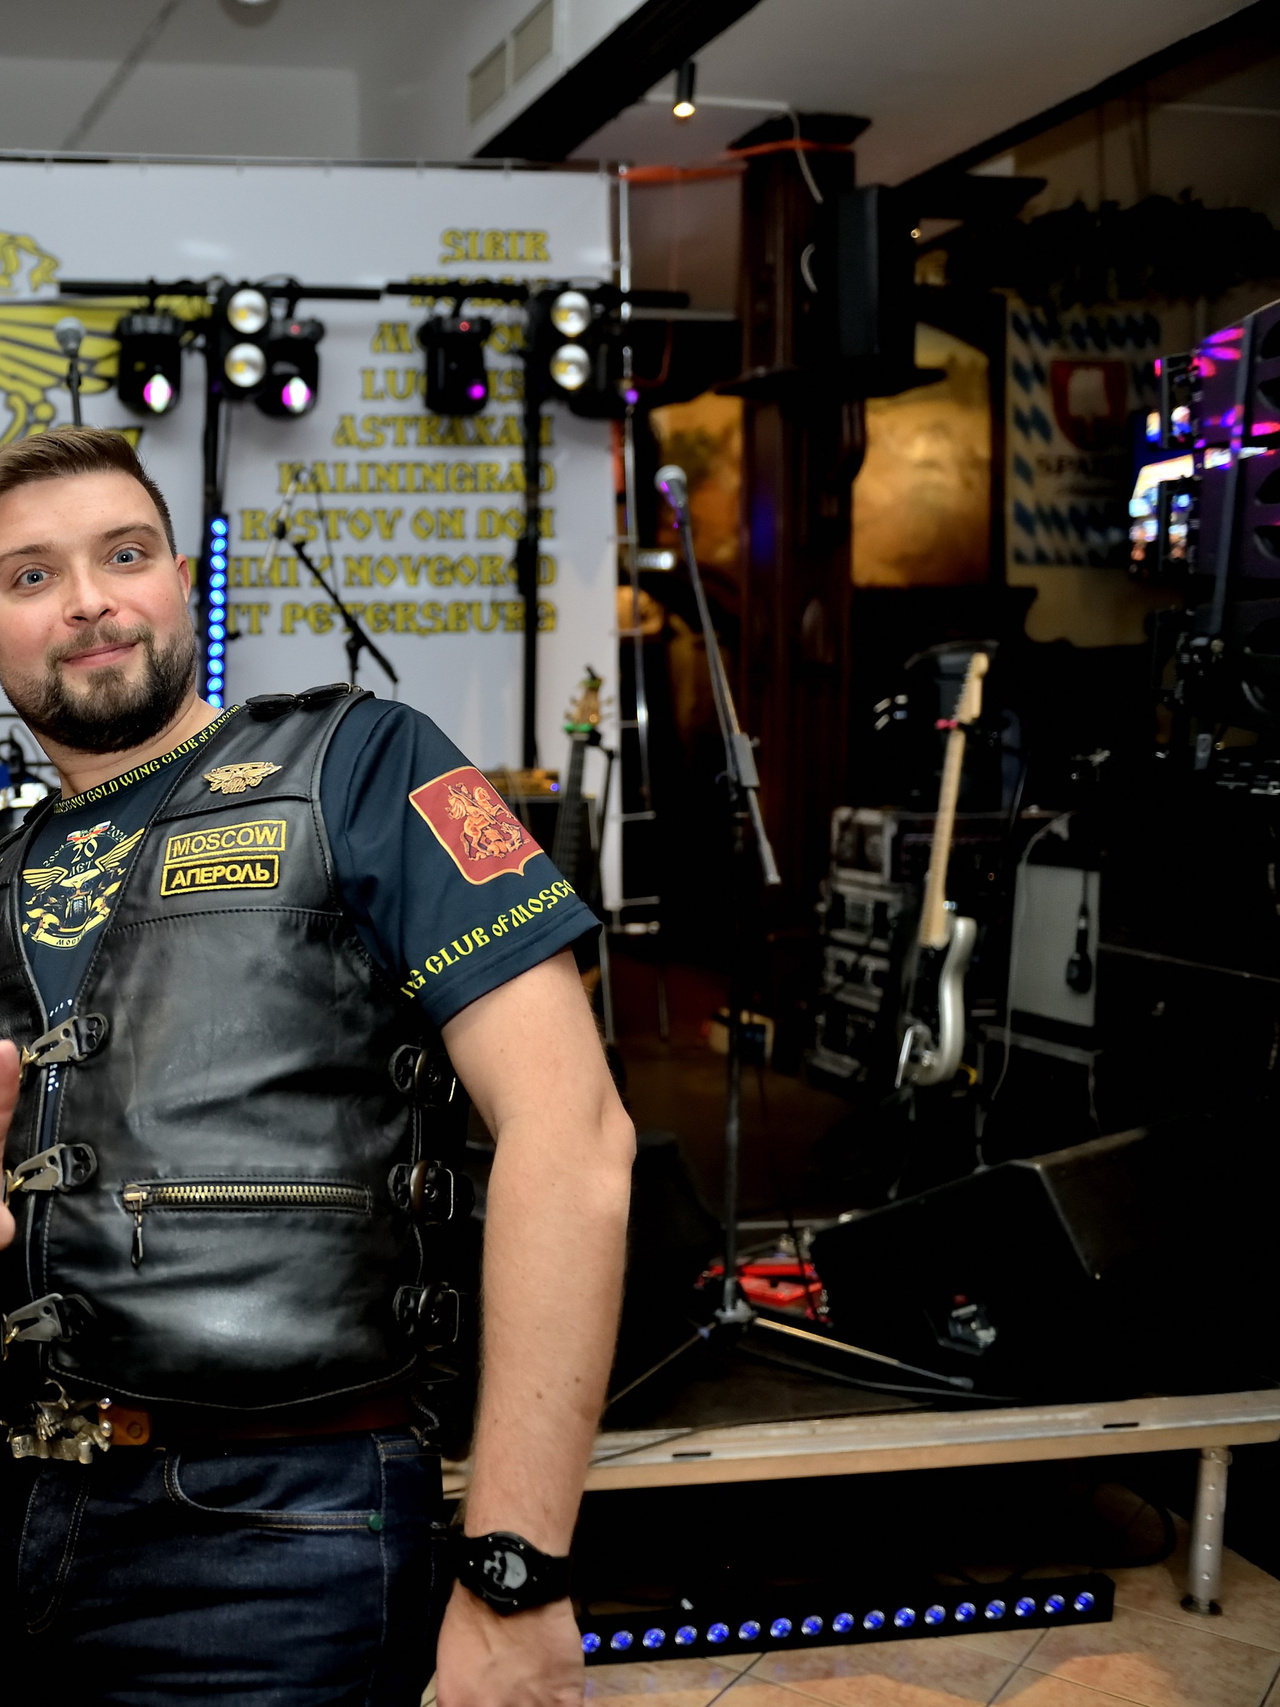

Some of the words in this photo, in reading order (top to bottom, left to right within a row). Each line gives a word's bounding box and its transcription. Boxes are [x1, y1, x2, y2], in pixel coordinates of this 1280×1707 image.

[440, 229, 549, 263] SIBIR
[239, 508, 403, 541] ROSTOV
[411, 508, 467, 541] ON
[86, 779, 119, 802] GOLD
[120, 760, 161, 787] WING
[161, 737, 199, 764] CLUB
[70, 838, 98, 864] 20
[171, 826, 279, 858] MOSCOW
[170, 863, 271, 889] АПЕРОЛЬ
[424, 927, 491, 975] CLUB
